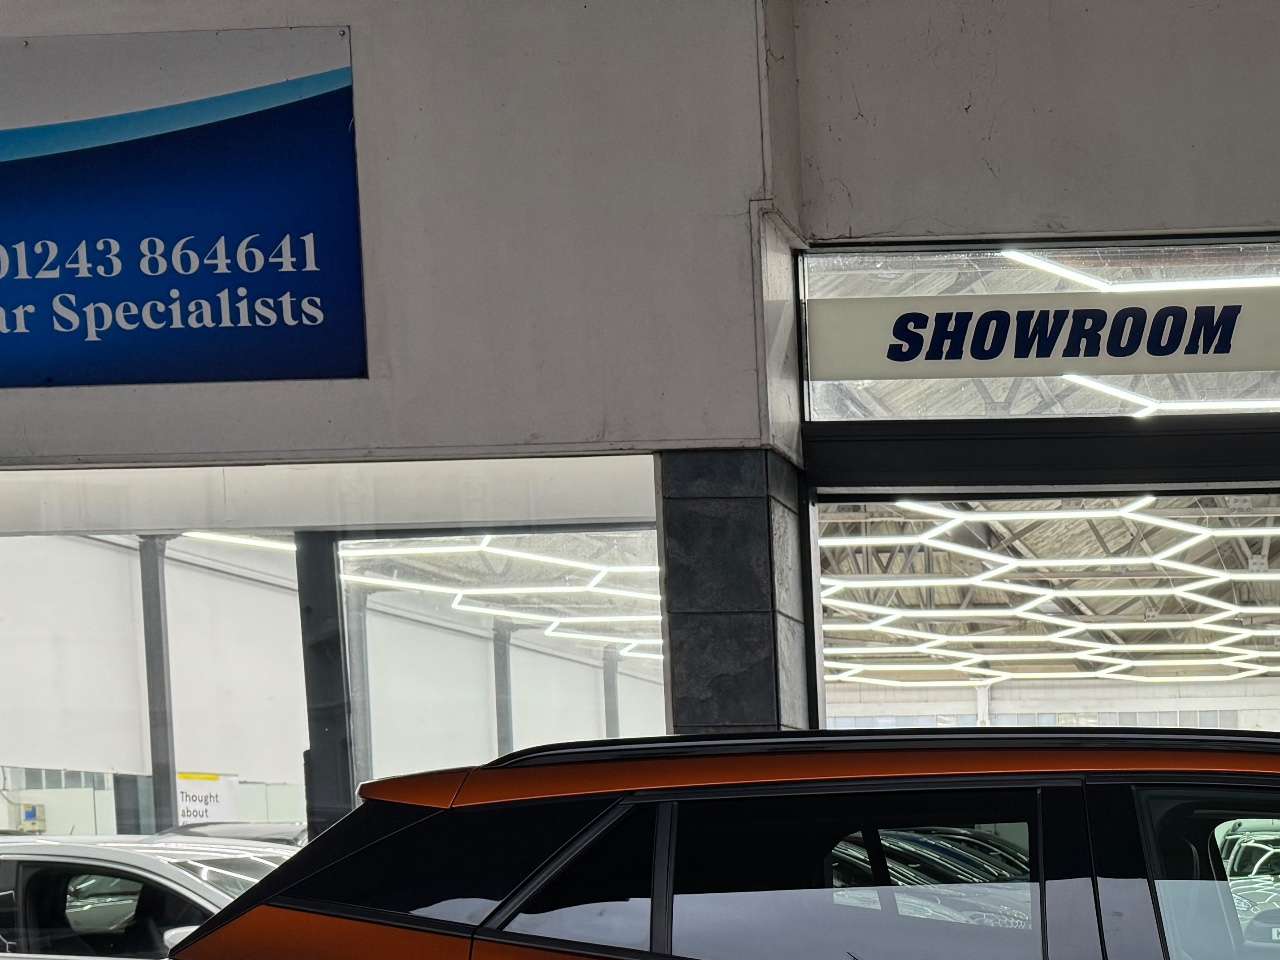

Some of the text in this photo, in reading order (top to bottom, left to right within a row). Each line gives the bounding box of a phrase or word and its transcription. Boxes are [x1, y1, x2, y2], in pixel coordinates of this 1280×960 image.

[139, 232, 321, 277] 864641
[51, 286, 325, 342] Specialists
[886, 304, 1242, 362] SHOWROOM
[180, 791, 219, 806] Thought
[181, 807, 209, 818] about
